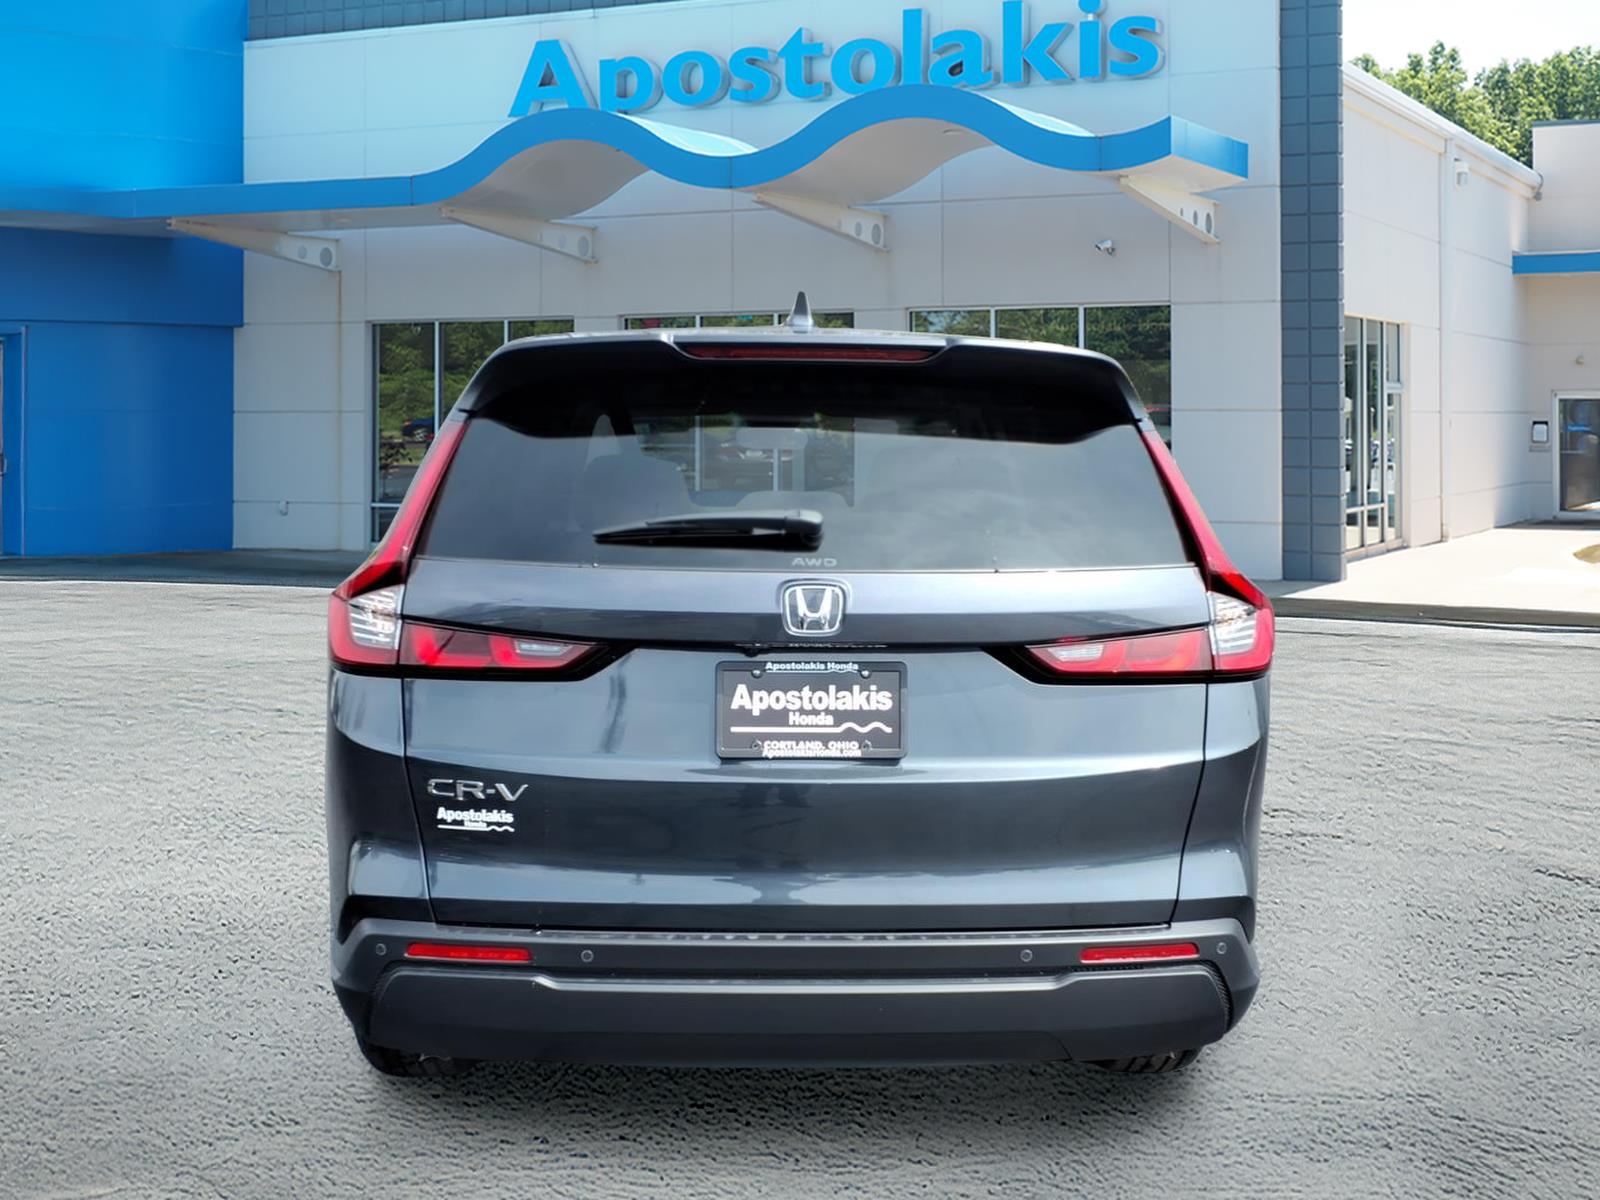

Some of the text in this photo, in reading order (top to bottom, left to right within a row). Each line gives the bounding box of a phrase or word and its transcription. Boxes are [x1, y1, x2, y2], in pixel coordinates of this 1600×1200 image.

[508, 0, 1164, 117] Apostolakis
[791, 557, 837, 567] AWD
[765, 662, 859, 671] Apostolakis Honda
[730, 684, 893, 716] Apostolakis
[788, 712, 834, 726] Honda
[827, 740, 860, 750] OHIO
[427, 778, 529, 801] CR-V
[436, 807, 514, 823] Apostolakis
